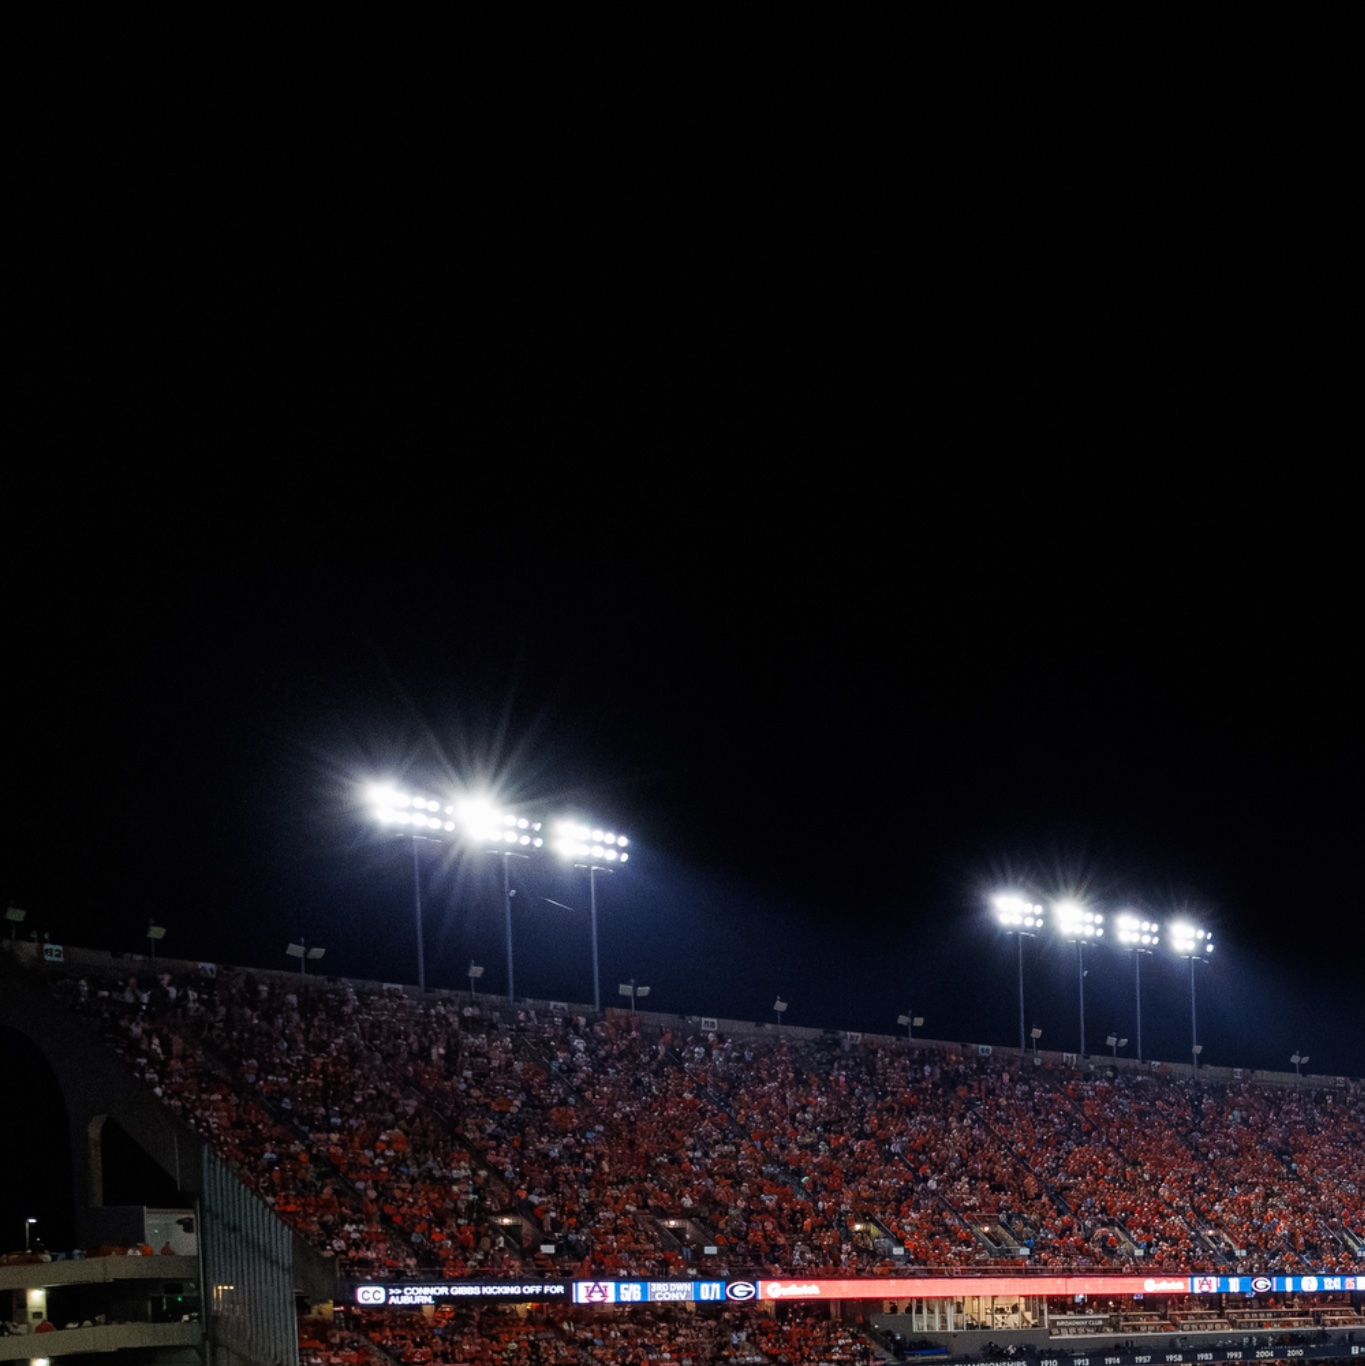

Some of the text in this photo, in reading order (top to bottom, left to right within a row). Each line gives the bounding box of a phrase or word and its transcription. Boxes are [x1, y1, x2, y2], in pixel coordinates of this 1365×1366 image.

[403, 1286, 449, 1296] CONNOR
[450, 1286, 481, 1295] GIBBS
[482, 1286, 520, 1295] KICKING
[522, 1285, 542, 1294] OFF
[543, 1285, 565, 1294] FOR
[619, 1283, 641, 1301] 5/6
[650, 1283, 691, 1292] 3RD DWN
[361, 1289, 382, 1301] CC
[655, 1291, 686, 1301] CONV
[1073, 1358, 1090, 1366] 1913
[1135, 1355, 1151, 1364] 1957
[1226, 1351, 1242, 1359] 1993
[1255, 1350, 1274, 1358] 2004
[1287, 1349, 1304, 1357] 2010
